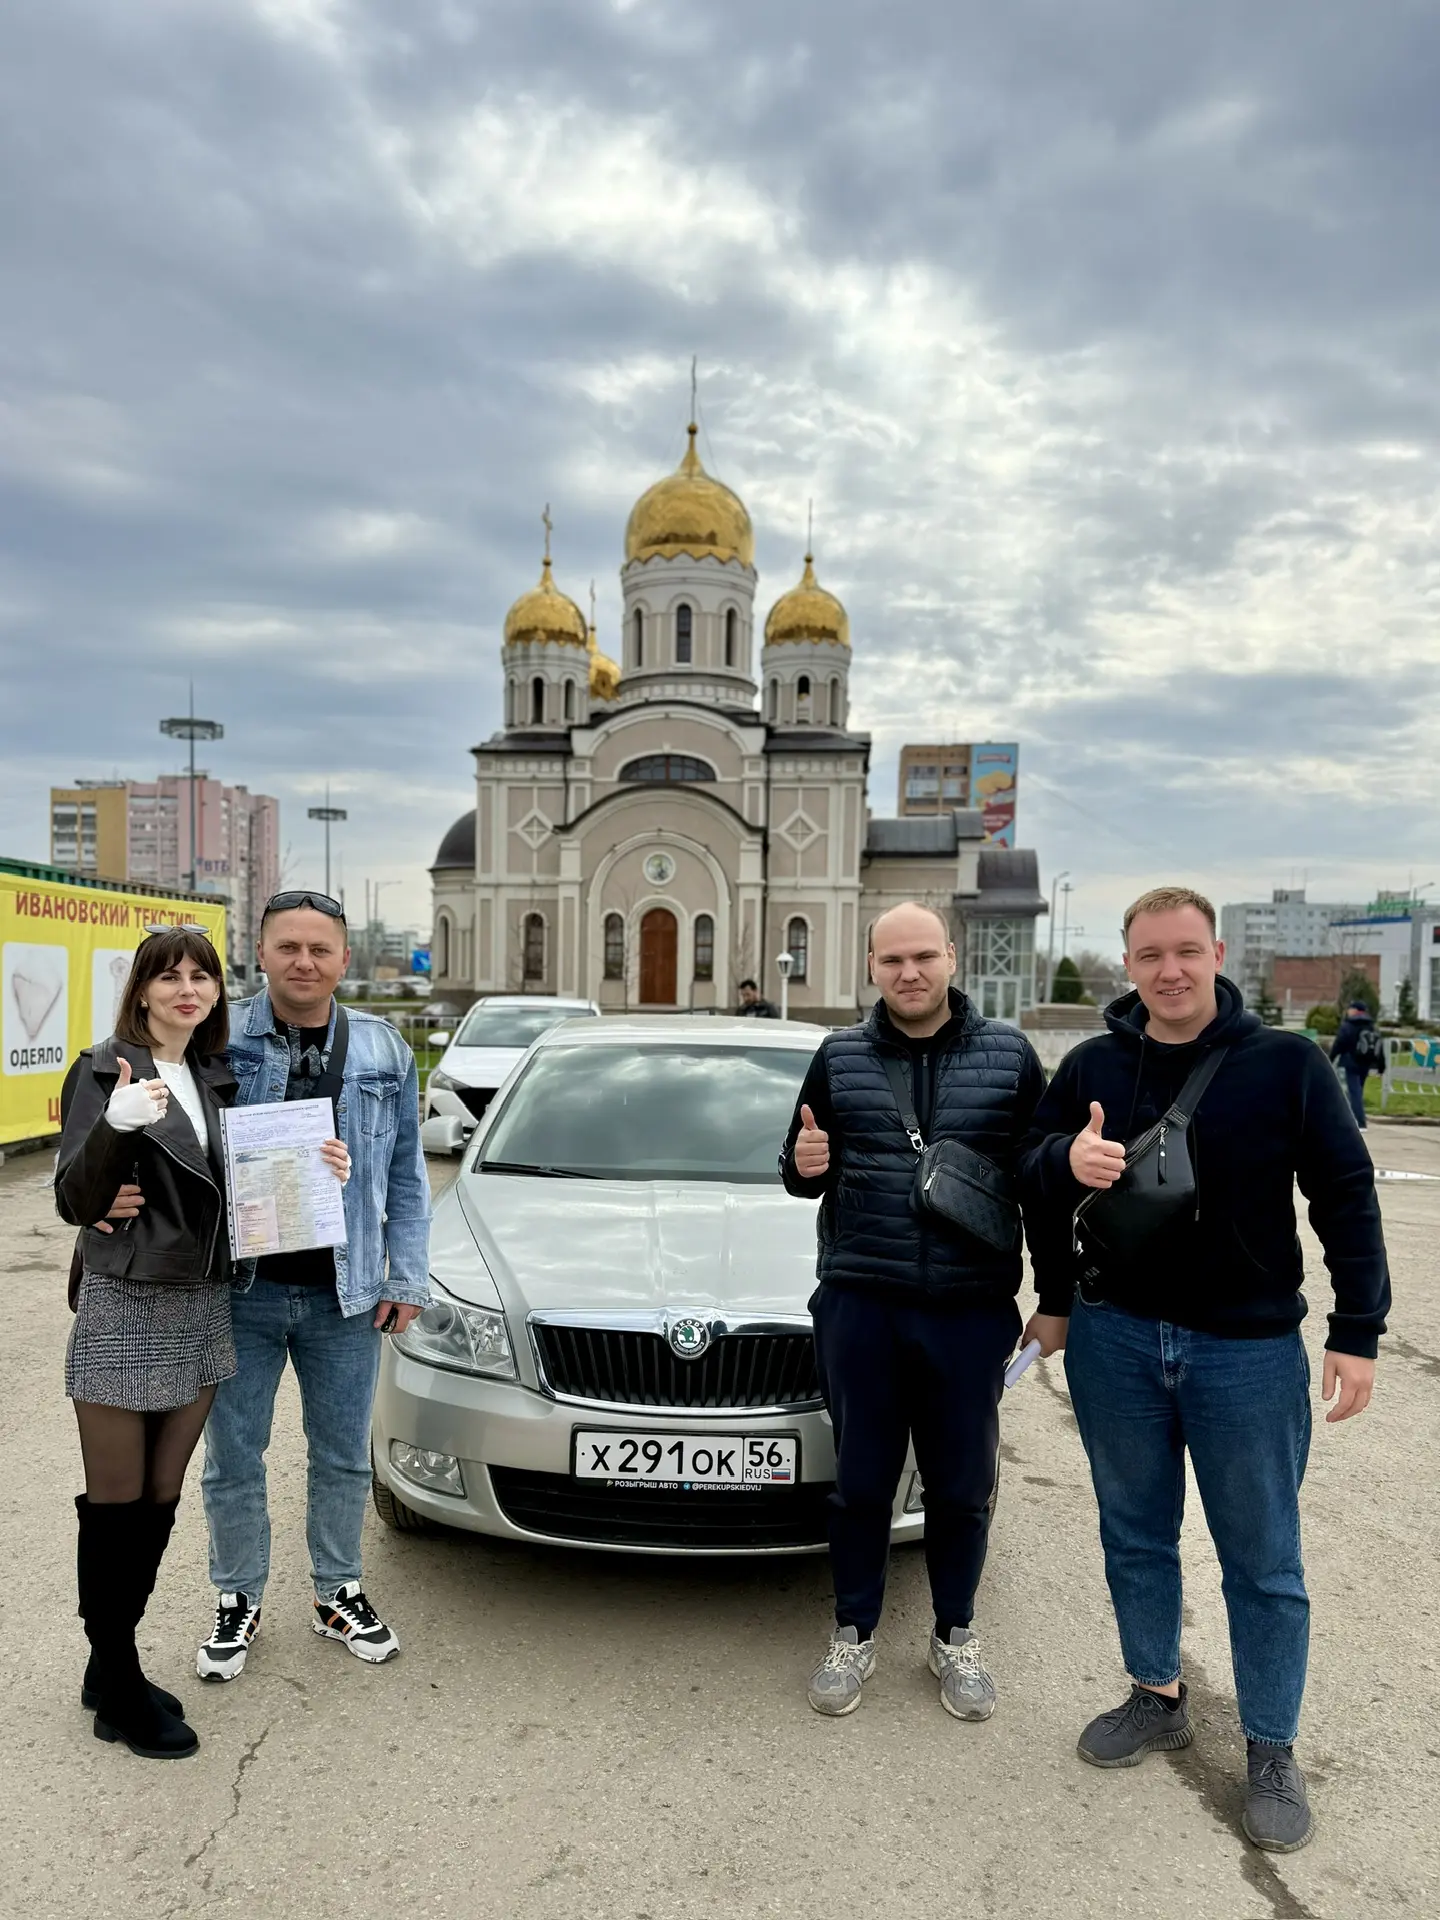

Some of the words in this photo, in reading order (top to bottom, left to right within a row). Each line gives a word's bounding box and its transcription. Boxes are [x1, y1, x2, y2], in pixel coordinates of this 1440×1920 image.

[16, 891, 130, 927] ИВАНОВСКИЙ
[10, 1046, 63, 1070] ОДЕЯЛО
[749, 1441, 783, 1467] 56
[745, 1468, 771, 1479] RUS
[614, 1481, 657, 1489] РОЗЫГРЫШ
[658, 1482, 679, 1490] АВТО
[692, 1483, 762, 1491] @PEREKUPSKIEDVIJ
